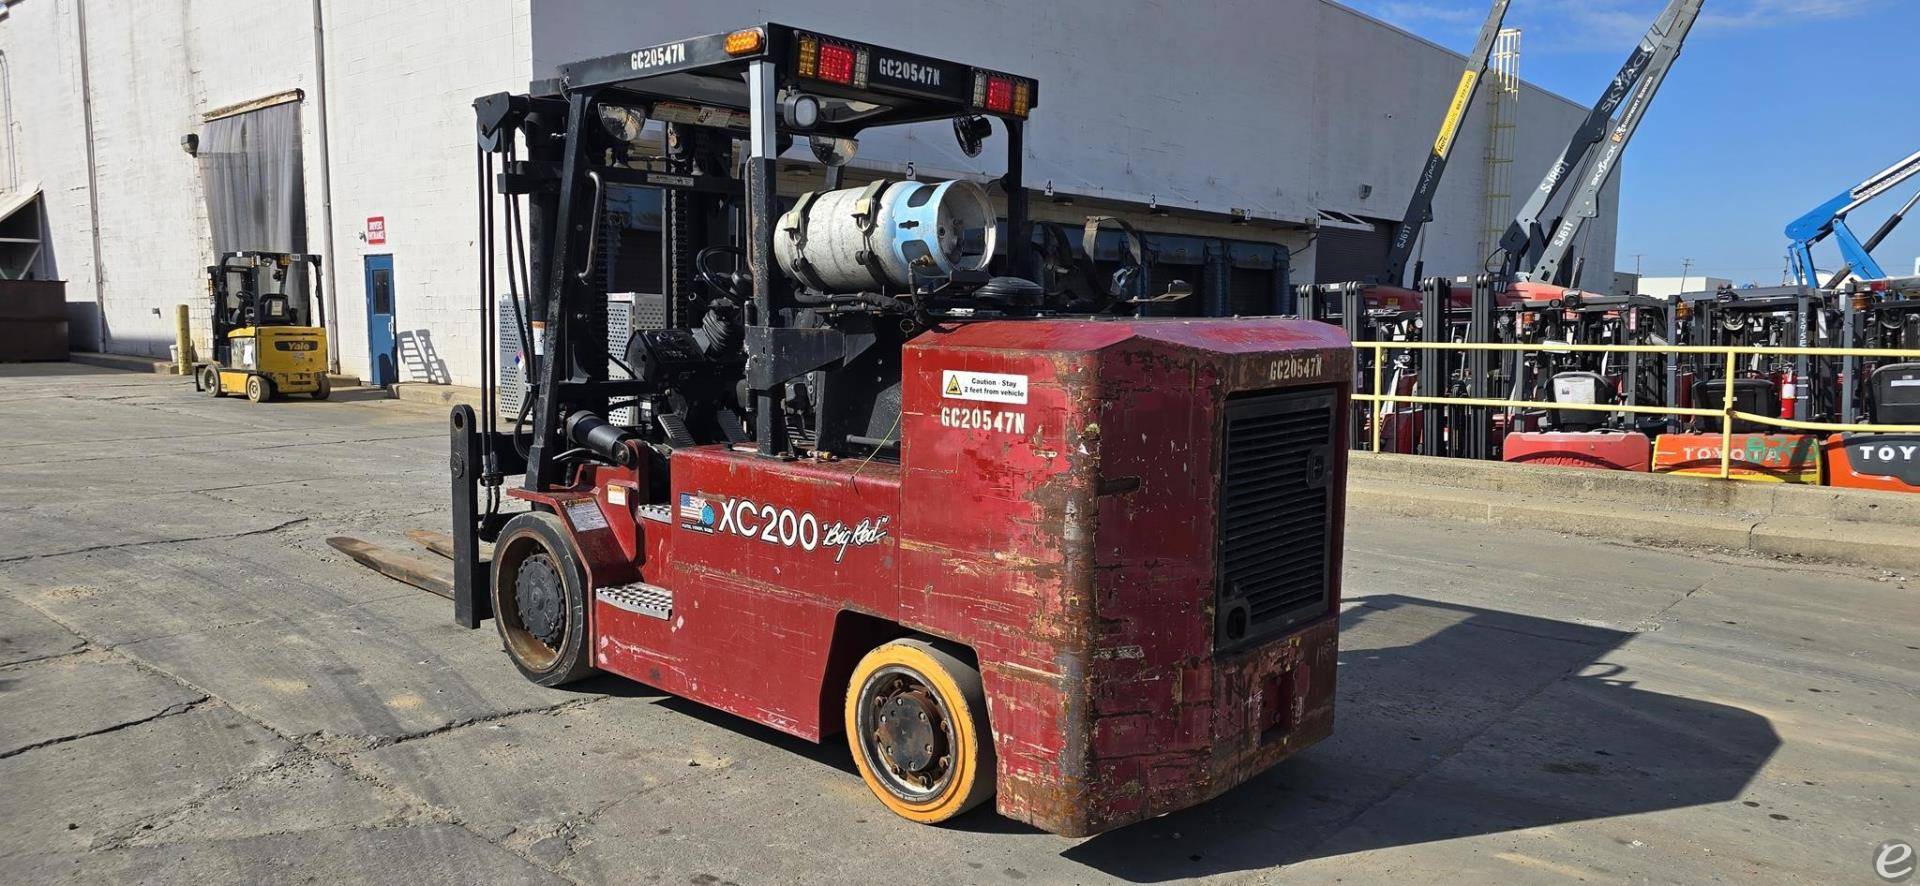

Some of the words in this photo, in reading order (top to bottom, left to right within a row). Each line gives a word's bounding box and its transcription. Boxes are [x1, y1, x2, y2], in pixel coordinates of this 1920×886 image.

[631, 43, 685, 70] GC20547N
[879, 58, 940, 86] GC20547N
[1602, 44, 1656, 113] SKYJACK
[906, 162, 914, 177] 5
[1540, 156, 1569, 194] SJ86T
[1047, 180, 1053, 193] 4
[1397, 224, 1411, 249] SJ61T
[1554, 220, 1574, 247] SJ61T
[287, 342, 310, 351] Yale
[1270, 357, 1322, 380] GC20547N
[970, 386, 983, 394] feet
[984, 387, 999, 395] from
[1000, 389, 1025, 397] vehicle
[971, 377, 997, 386] Caution
[1001, 379, 1017, 388] Stay
[941, 407, 1025, 434] GC20547N
[1859, 445, 1917, 461] TOY
[718, 498, 818, 550] XC200
